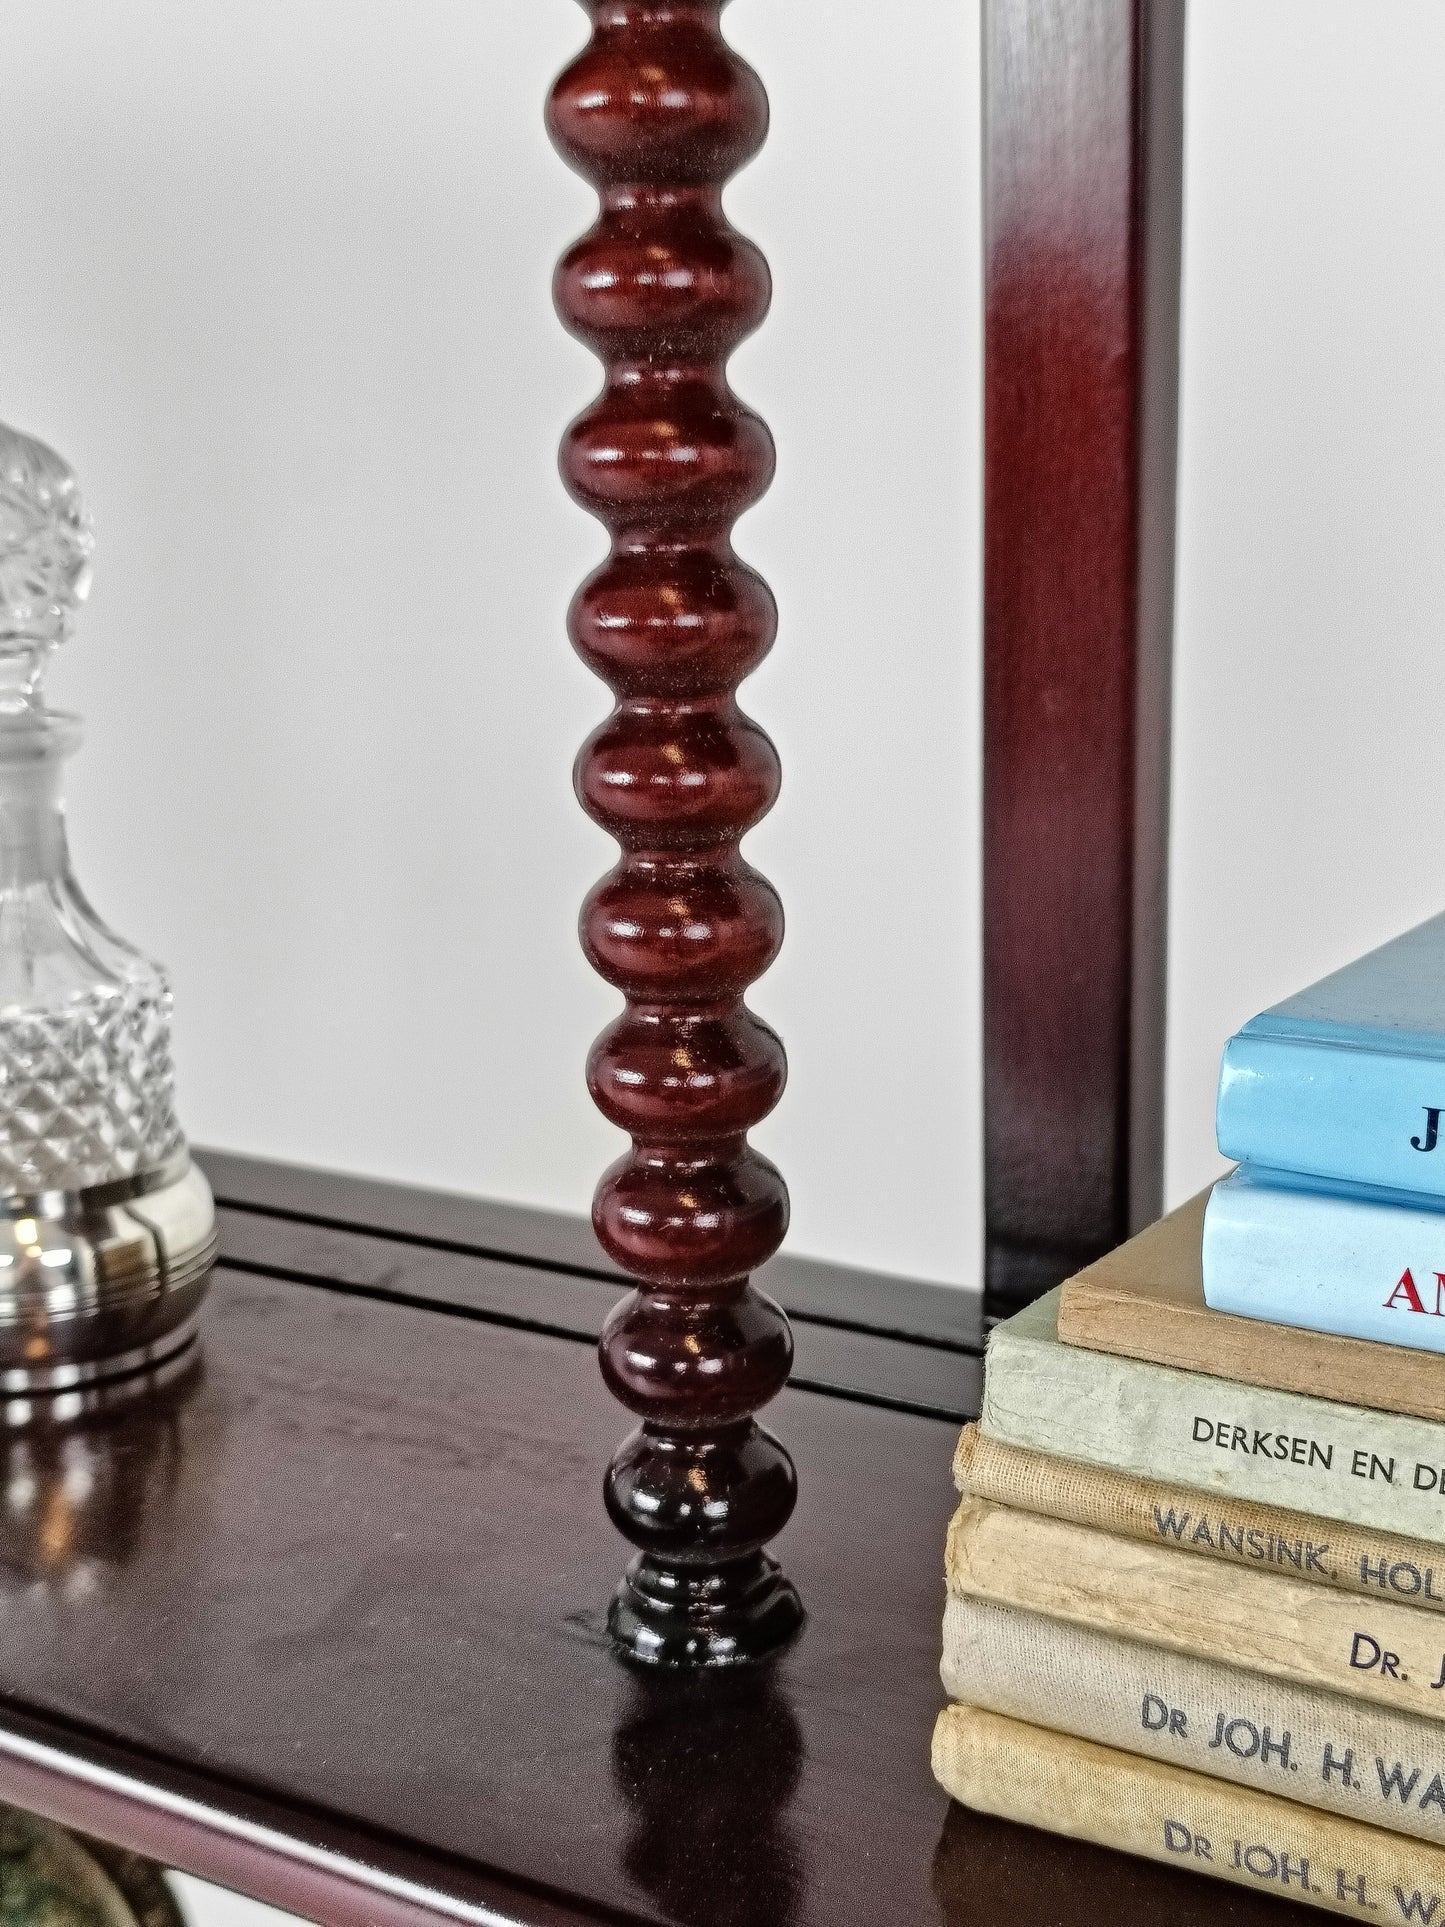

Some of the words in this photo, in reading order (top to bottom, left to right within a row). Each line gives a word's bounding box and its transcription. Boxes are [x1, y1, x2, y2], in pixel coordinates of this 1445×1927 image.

[1382, 1267, 1445, 1316] A
[1192, 1416, 1333, 1470] DERKSEN
[1351, 1450, 1395, 1484] EN
[1361, 1555, 1443, 1602] HOL
[1208, 1713, 1298, 1772] JOH.
[1322, 1743, 1361, 1789] H.
[1232, 1841, 1321, 1895] JOH.
[1336, 1870, 1378, 1910] H.
[1393, 1885, 1445, 1927] W
